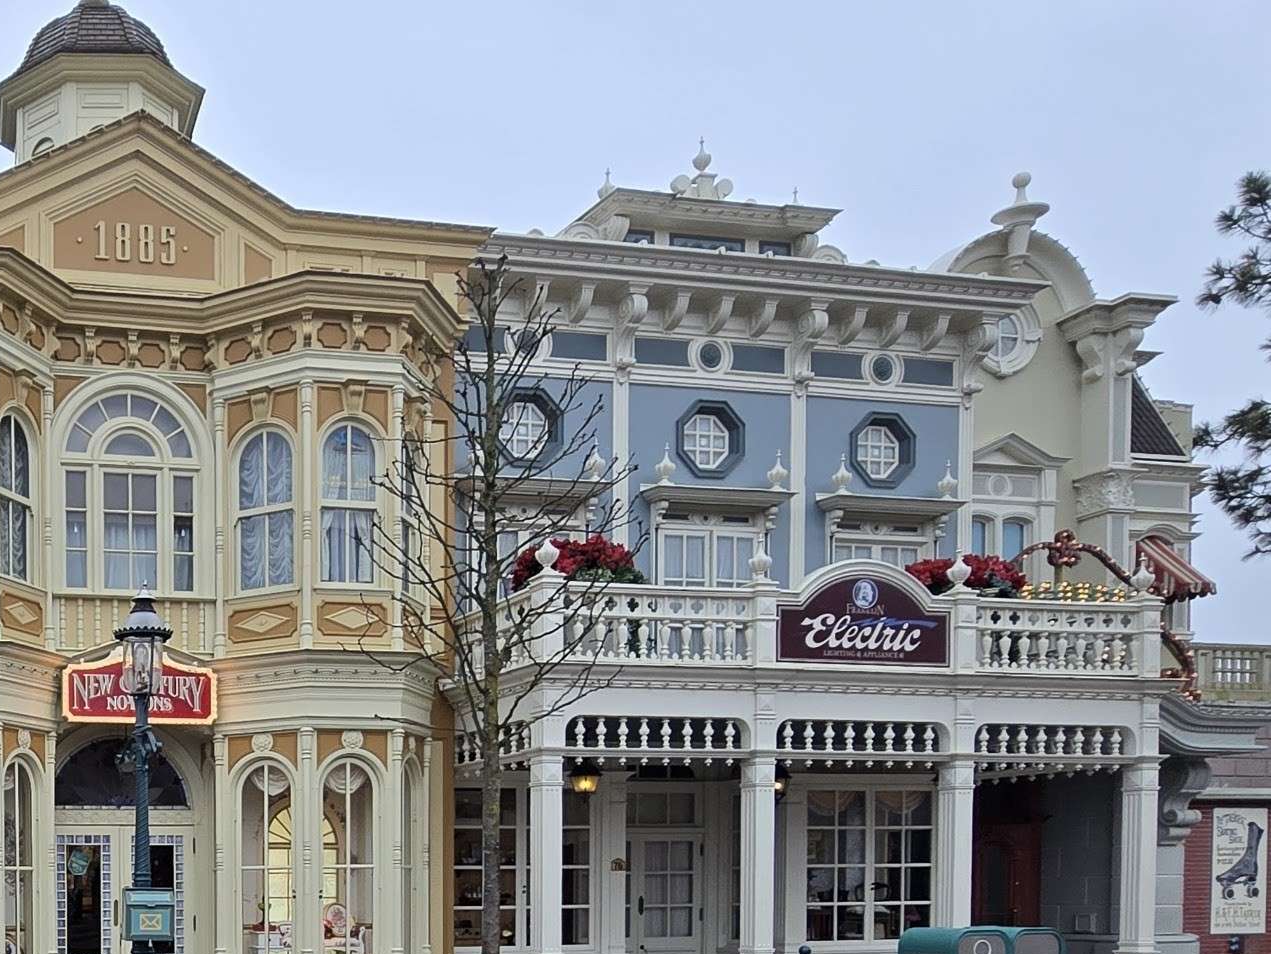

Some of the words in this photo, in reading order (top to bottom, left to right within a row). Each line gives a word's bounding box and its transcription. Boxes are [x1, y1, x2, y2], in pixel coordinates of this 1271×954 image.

[94, 220, 176, 265] 1885
[800, 613, 922, 651] Electric
[72, 673, 116, 710] NEW
[119, 674, 206, 712] CTURY
[106, 695, 174, 713] NOTNS
